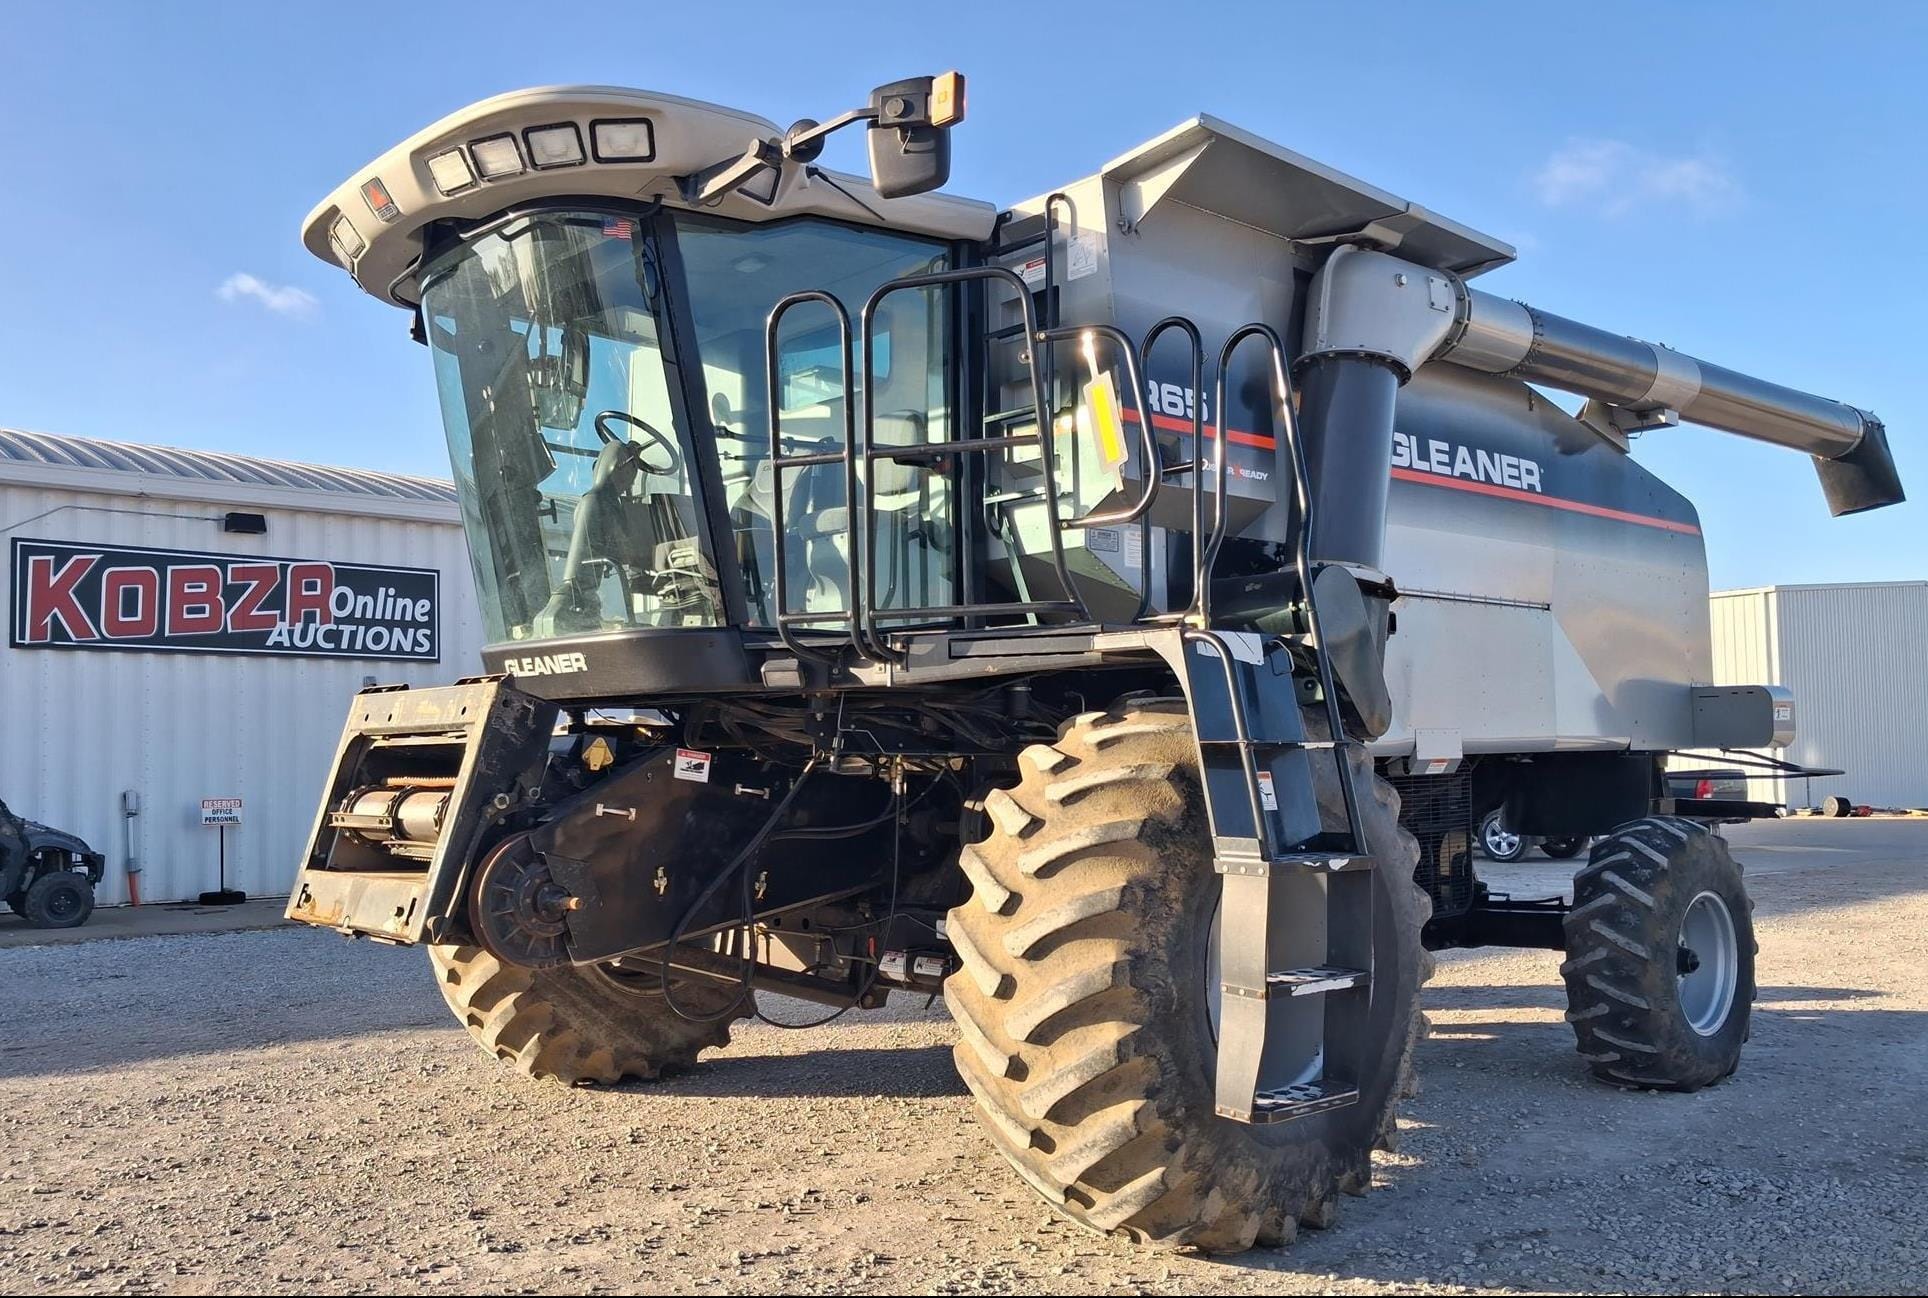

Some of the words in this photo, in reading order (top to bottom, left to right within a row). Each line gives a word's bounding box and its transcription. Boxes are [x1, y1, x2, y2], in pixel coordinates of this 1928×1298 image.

[1391, 431, 1543, 493] GLEANER
[1239, 468, 1268, 480] READY
[25, 554, 336, 644] KOBZA
[328, 585, 431, 622] Online
[266, 622, 431, 653] AUCTIONS
[504, 652, 588, 678] GLEANER
[203, 800, 241, 808] RESERVED
[211, 808, 233, 816] OFFICE
[204, 815, 240, 823] PERSONNEL
